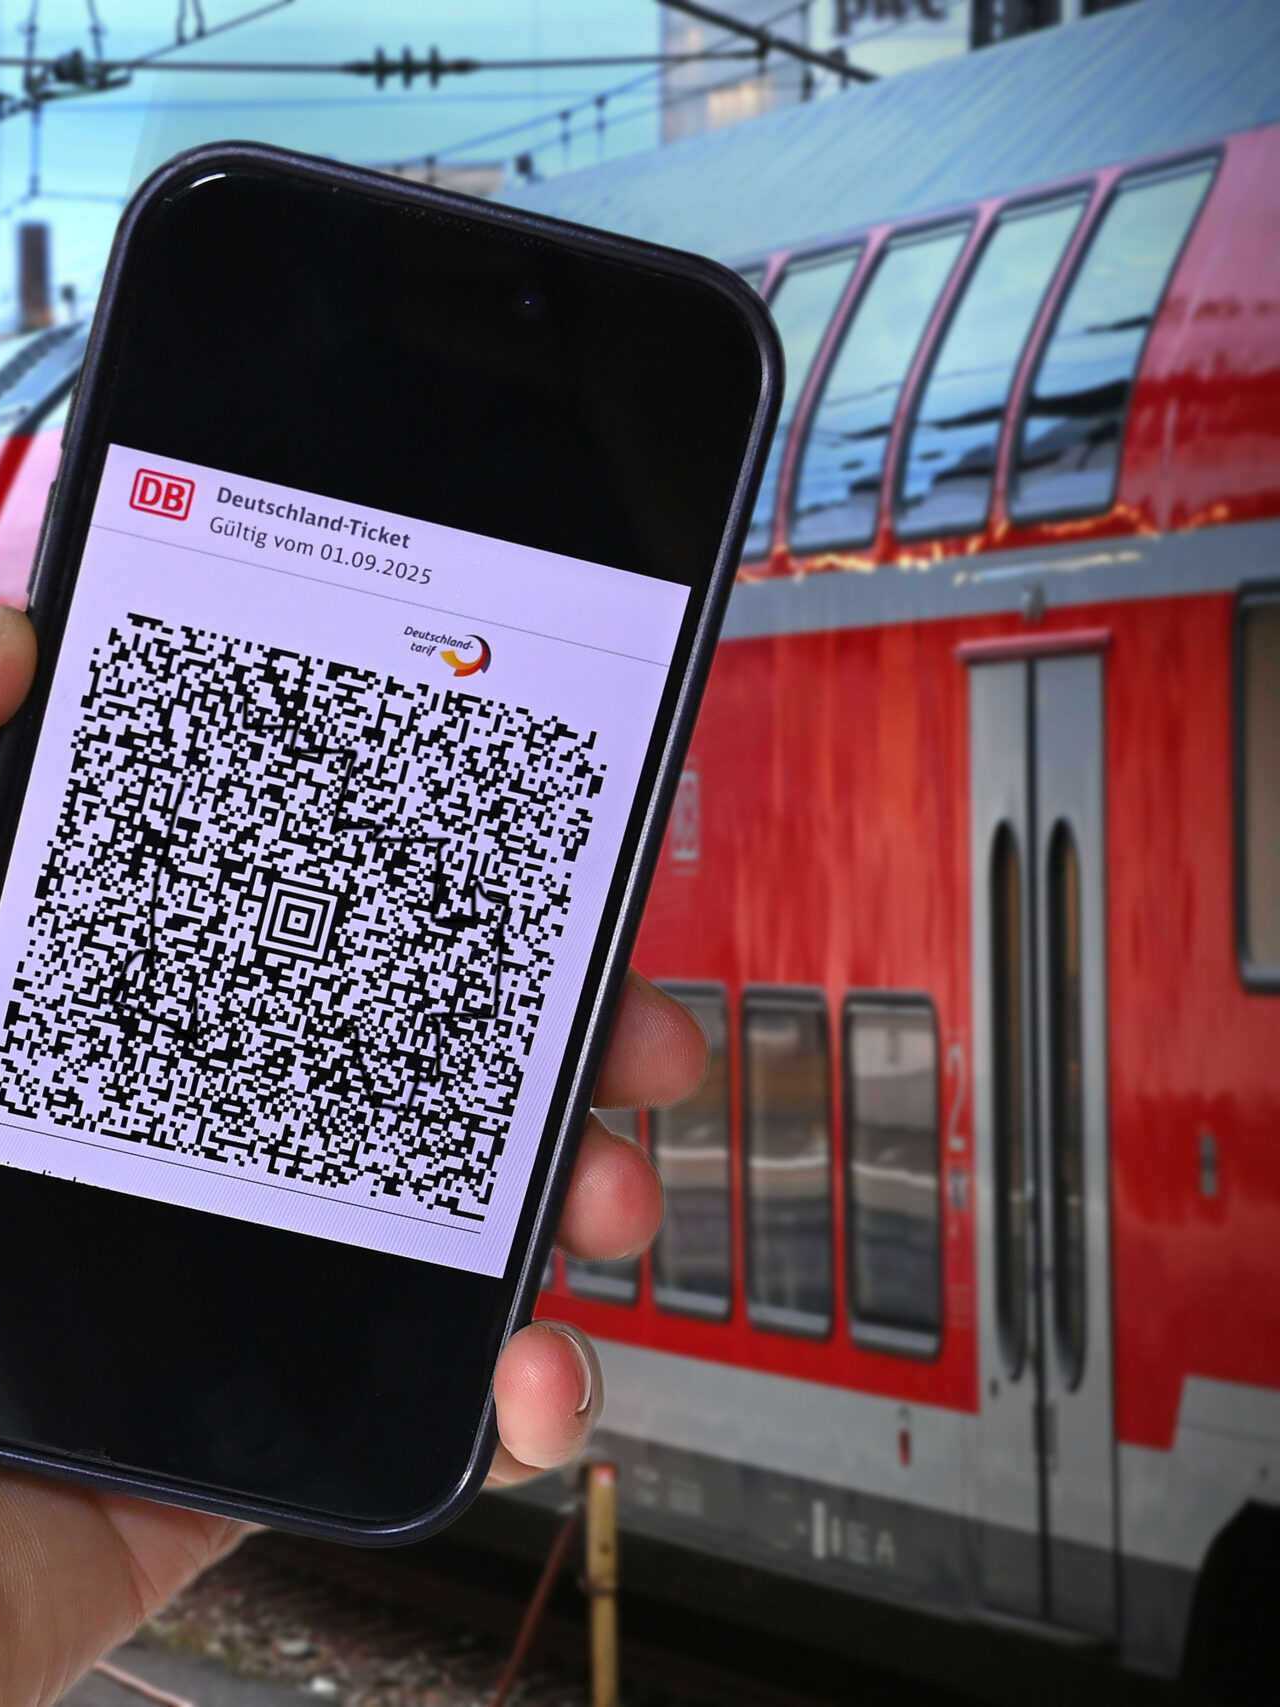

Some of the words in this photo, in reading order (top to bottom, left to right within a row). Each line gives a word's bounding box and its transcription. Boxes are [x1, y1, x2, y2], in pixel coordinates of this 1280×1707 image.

[137, 475, 186, 513] DB
[216, 486, 412, 549] Deutschland-Ticket
[209, 516, 268, 549] Gültig
[274, 535, 315, 557] vom
[319, 543, 433, 585] 01.09.2025
[403, 625, 475, 651] Deutschland-
[410, 641, 438, 657] tarif
